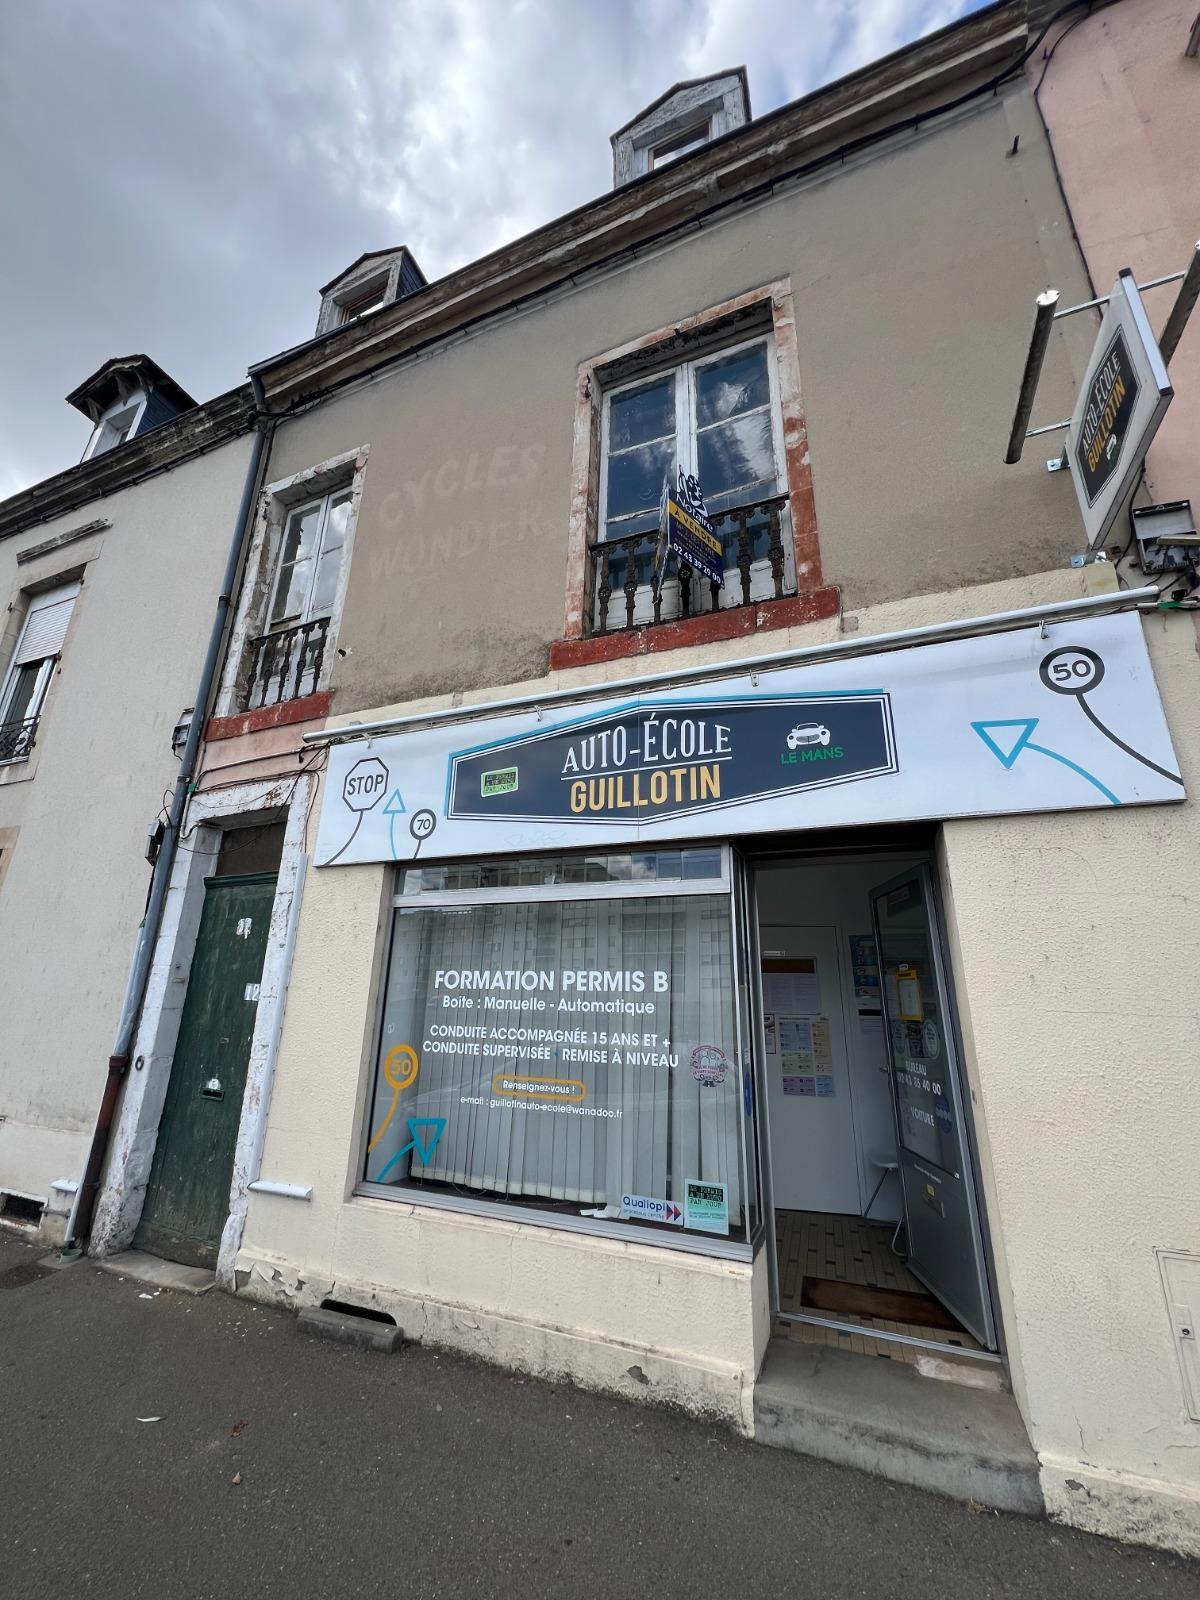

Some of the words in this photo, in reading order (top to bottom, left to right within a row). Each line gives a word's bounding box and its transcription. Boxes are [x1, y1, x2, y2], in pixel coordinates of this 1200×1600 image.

[1088, 376, 1126, 473] GUILLOTIN
[379, 444, 546, 528] CYCLES
[676, 492, 715, 533] Notaire
[683, 516, 718, 550] VENDRE
[673, 542, 683, 556] 02
[684, 551, 693, 563] 43
[693, 558, 702, 570] 39
[703, 565, 711, 577] 29
[1052, 659, 1091, 682] 50
[561, 712, 733, 774] AUTO-ÉCOLE
[781, 751, 798, 765] LE
[801, 746, 844, 762] MANS
[347, 773, 385, 796] STOP
[570, 764, 721, 813] GUILLOTIN
[417, 818, 431, 831] 70
[433, 969, 555, 992] FORMATION
[562, 970, 645, 992] PERMIS
[653, 970, 669, 993] B
[484, 996, 546, 1011] Manuelle
[557, 998, 655, 1017] Automatique
[430, 1024, 487, 1039] CONDUITE
[489, 1027, 588, 1044] ACCOMPAGNÉE
[592, 1031, 608, 1045] 15
[610, 1032, 639, 1047] ANS
[643, 1033, 658, 1047] ET
[662, 1037, 671, 1048] +
[422, 1041, 480, 1056] CONDUITE
[482, 1043, 551, 1060] SUPERVISÉE
[562, 1048, 609, 1064] REMISE
[611, 1047, 622, 1065] À
[626, 1051, 679, 1068] NIVEAU
[905, 1060, 927, 1076] BUREAU
[922, 1079, 931, 1092] 40
[932, 1081, 942, 1096] 00
[460, 1095, 484, 1106] e-mail
[490, 1098, 623, 1119] guillotinauto-ecole@wanadoo.fr
[910, 1104, 935, 1127] VOITURE
[623, 1196, 666, 1212] Qualiopi
